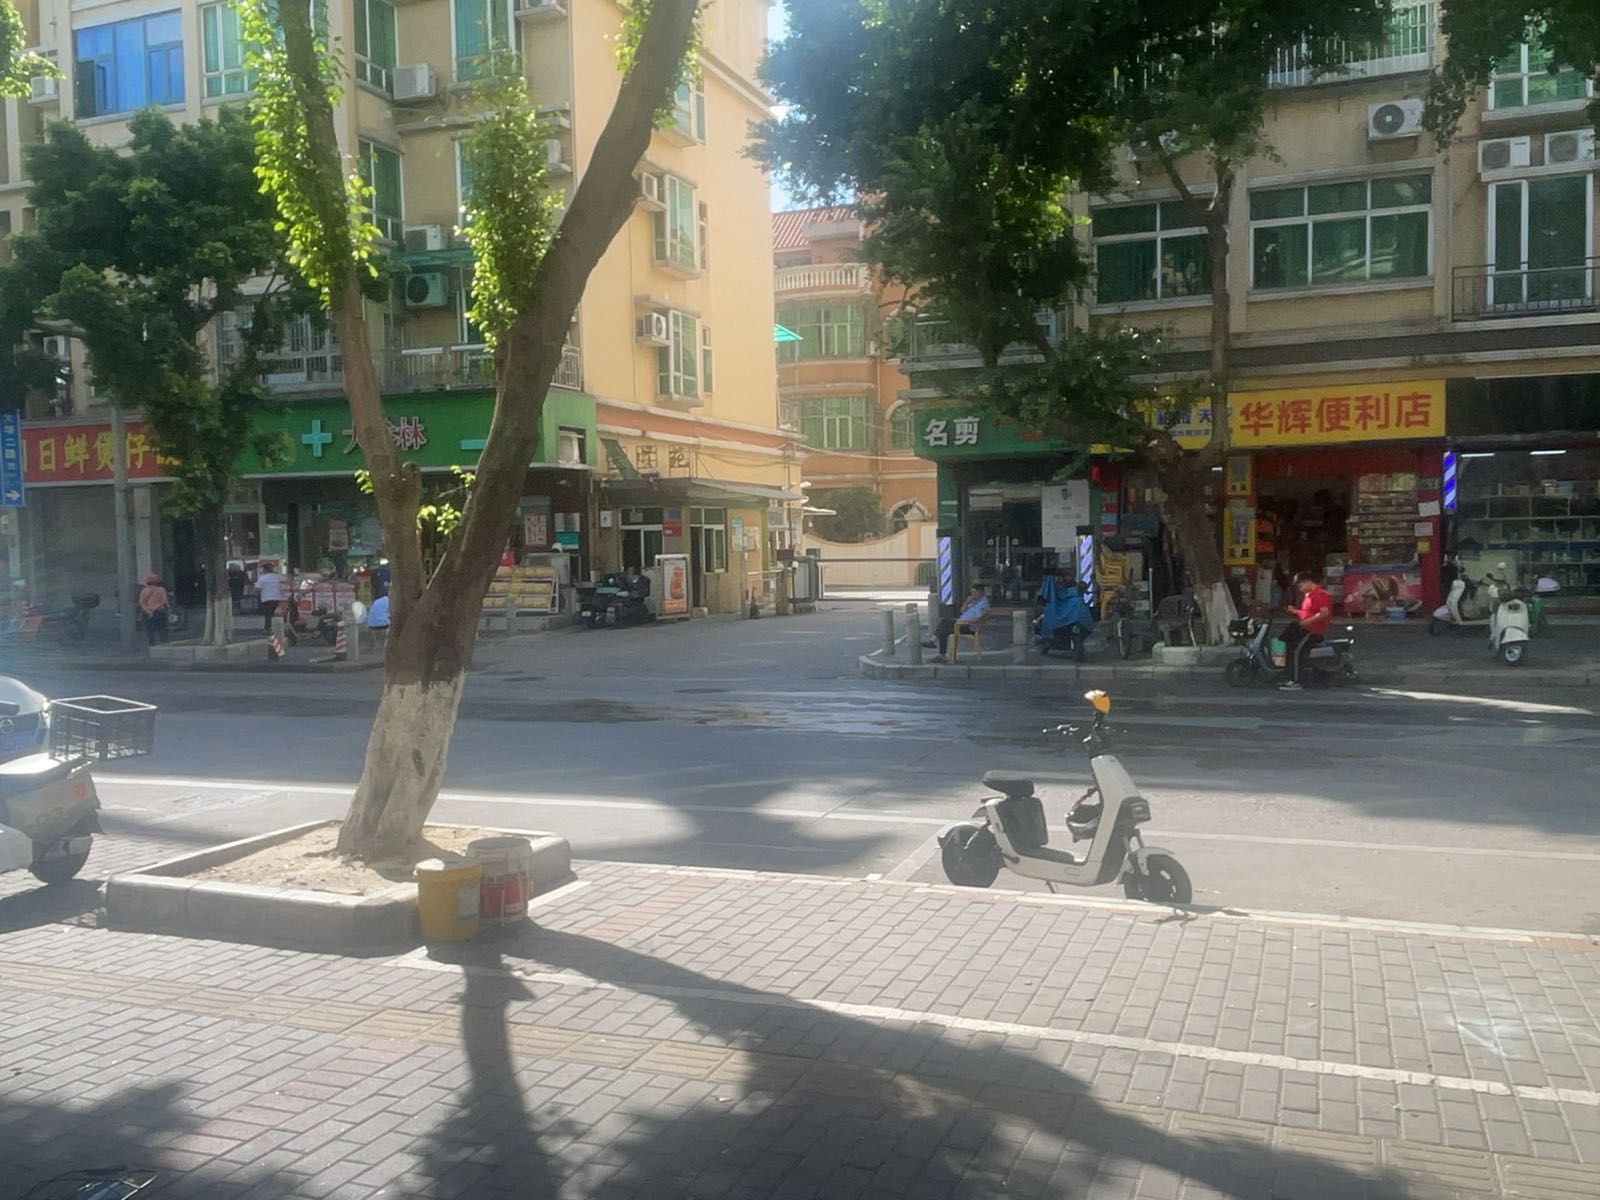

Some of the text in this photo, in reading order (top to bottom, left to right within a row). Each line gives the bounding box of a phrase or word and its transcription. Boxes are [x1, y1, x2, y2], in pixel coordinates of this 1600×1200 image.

[924, 416, 980, 446] 名剪
[1240, 391, 1432, 437] 华辉便利店
[342, 415, 427, 454] 大林
